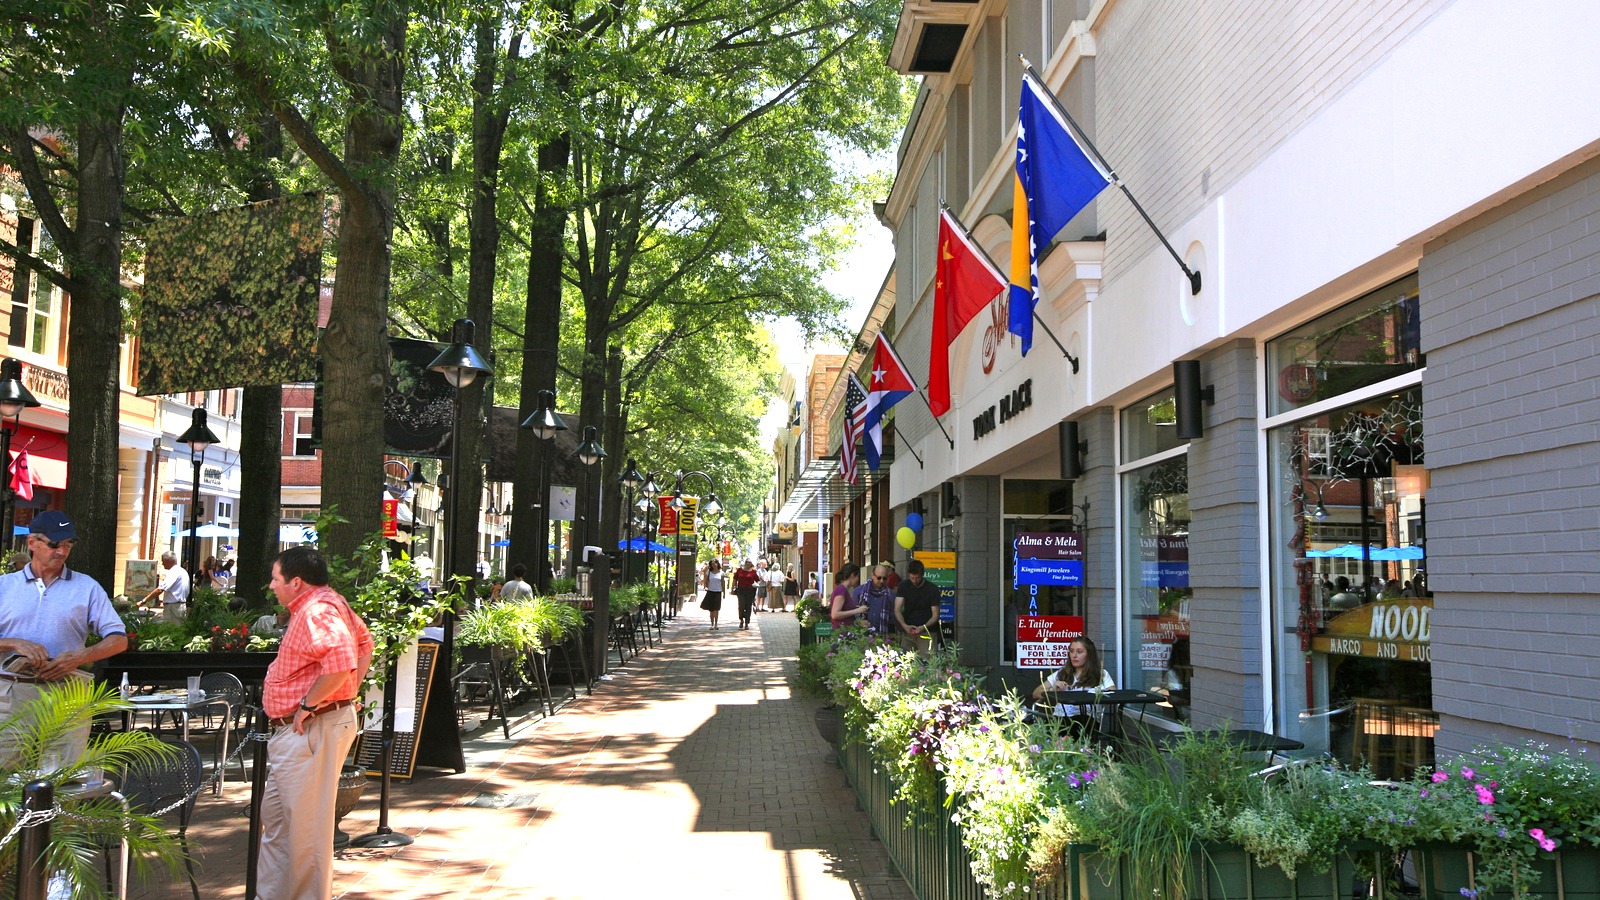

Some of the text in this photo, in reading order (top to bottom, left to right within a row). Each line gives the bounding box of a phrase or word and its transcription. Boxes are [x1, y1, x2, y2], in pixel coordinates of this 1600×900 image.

[973, 378, 1032, 440] YORK PLACE
[385, 502, 392, 511] 3
[681, 503, 695, 531] LOOK
[1018, 535, 1077, 547] Alma & Mela
[1021, 566, 1047, 574] Kingsmill
[1018, 619, 1053, 629] E. Tailor
[1370, 605, 1432, 641] NOOD
[1035, 628, 1082, 638] Alterations
[1330, 638, 1360, 655] MARCO
[1376, 642, 1397, 659] AND
